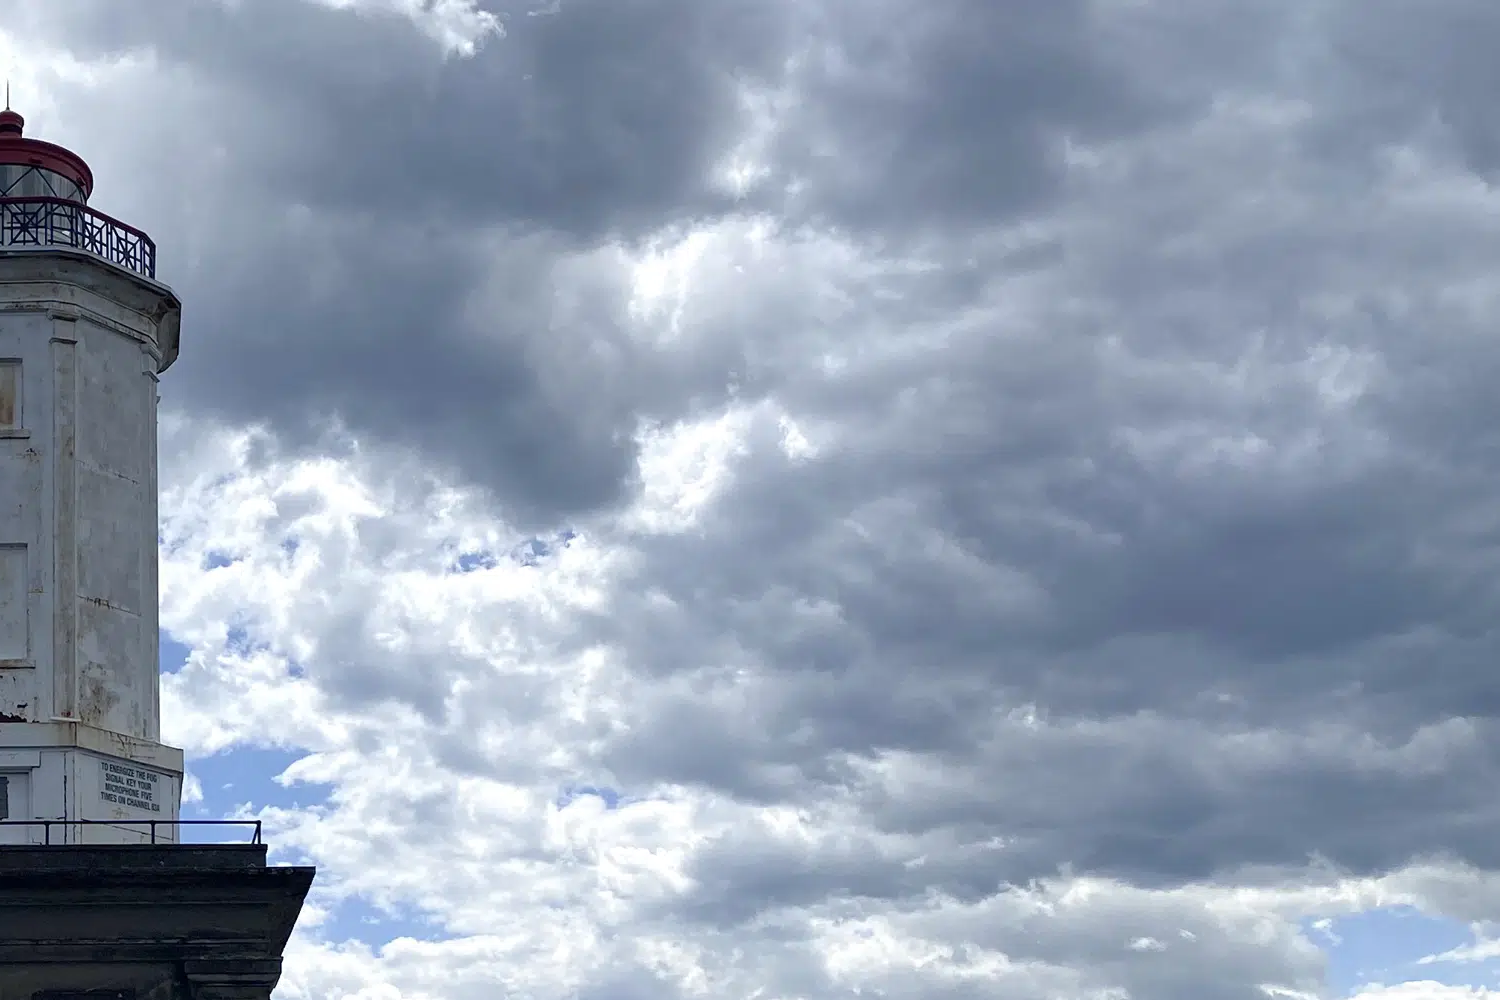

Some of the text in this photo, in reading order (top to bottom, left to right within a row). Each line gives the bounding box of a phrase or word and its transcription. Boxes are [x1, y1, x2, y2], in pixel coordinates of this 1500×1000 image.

[101, 762, 157, 782] TO ENERGIZE THE FOG
[105, 773, 151, 791] SIGNAL KEY YOUR
[101, 791, 117, 802] TIMES
[118, 795, 125, 804] ON
[127, 798, 150, 810] CHANNEL
[105, 783, 152, 801] MICROPHONE FIVE
